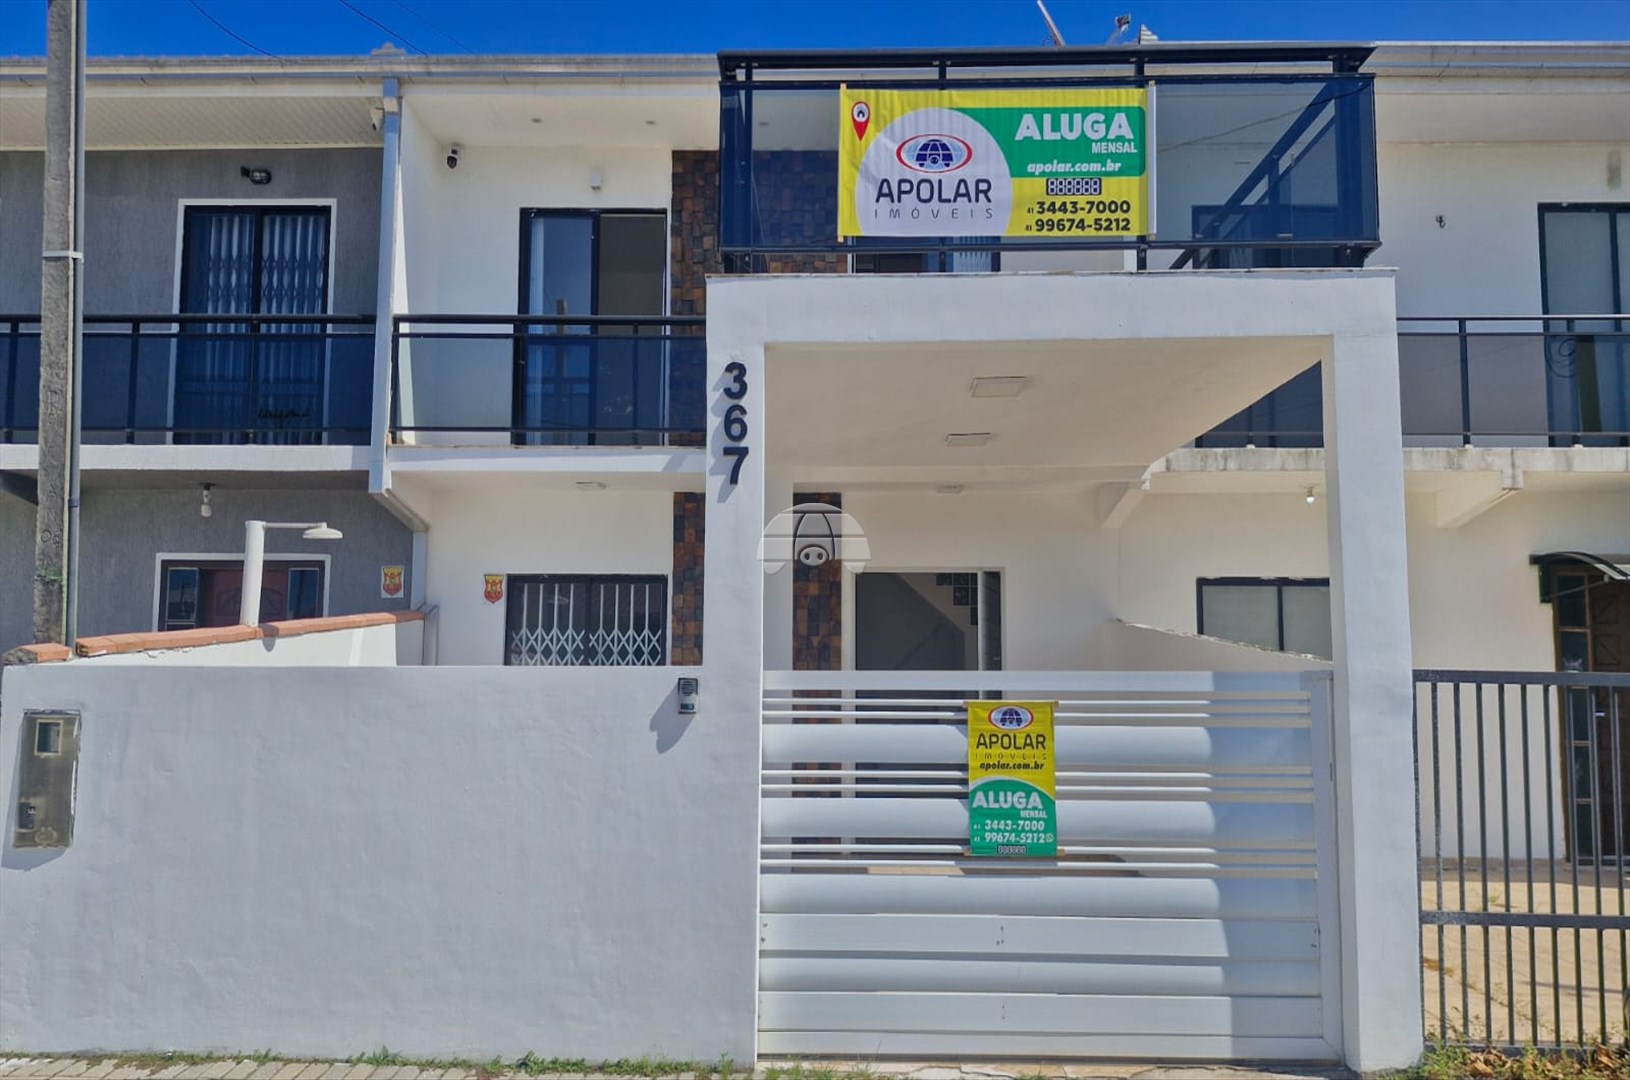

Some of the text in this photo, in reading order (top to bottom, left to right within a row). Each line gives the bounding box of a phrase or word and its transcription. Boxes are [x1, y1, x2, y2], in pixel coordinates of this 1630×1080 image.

[1015, 112, 1134, 141] ALUGA
[1092, 142, 1137, 153] MENSAL
[1027, 159, 1121, 175] apolar.com.br
[875, 178, 992, 204] APOLAR
[1036, 200, 1131, 214] 3443-7000
[1035, 218, 1131, 232] 99674-5212
[723, 361, 749, 485] 367
[976, 733, 1046, 750] APOLAR
[979, 761, 1044, 771] apolar.com.br
[972, 791, 1043, 809] ALUGA
[1020, 810, 1048, 818] MENSAL
[985, 820, 1045, 830] 3443-7000
[984, 832, 1046, 843] 99674-5212
